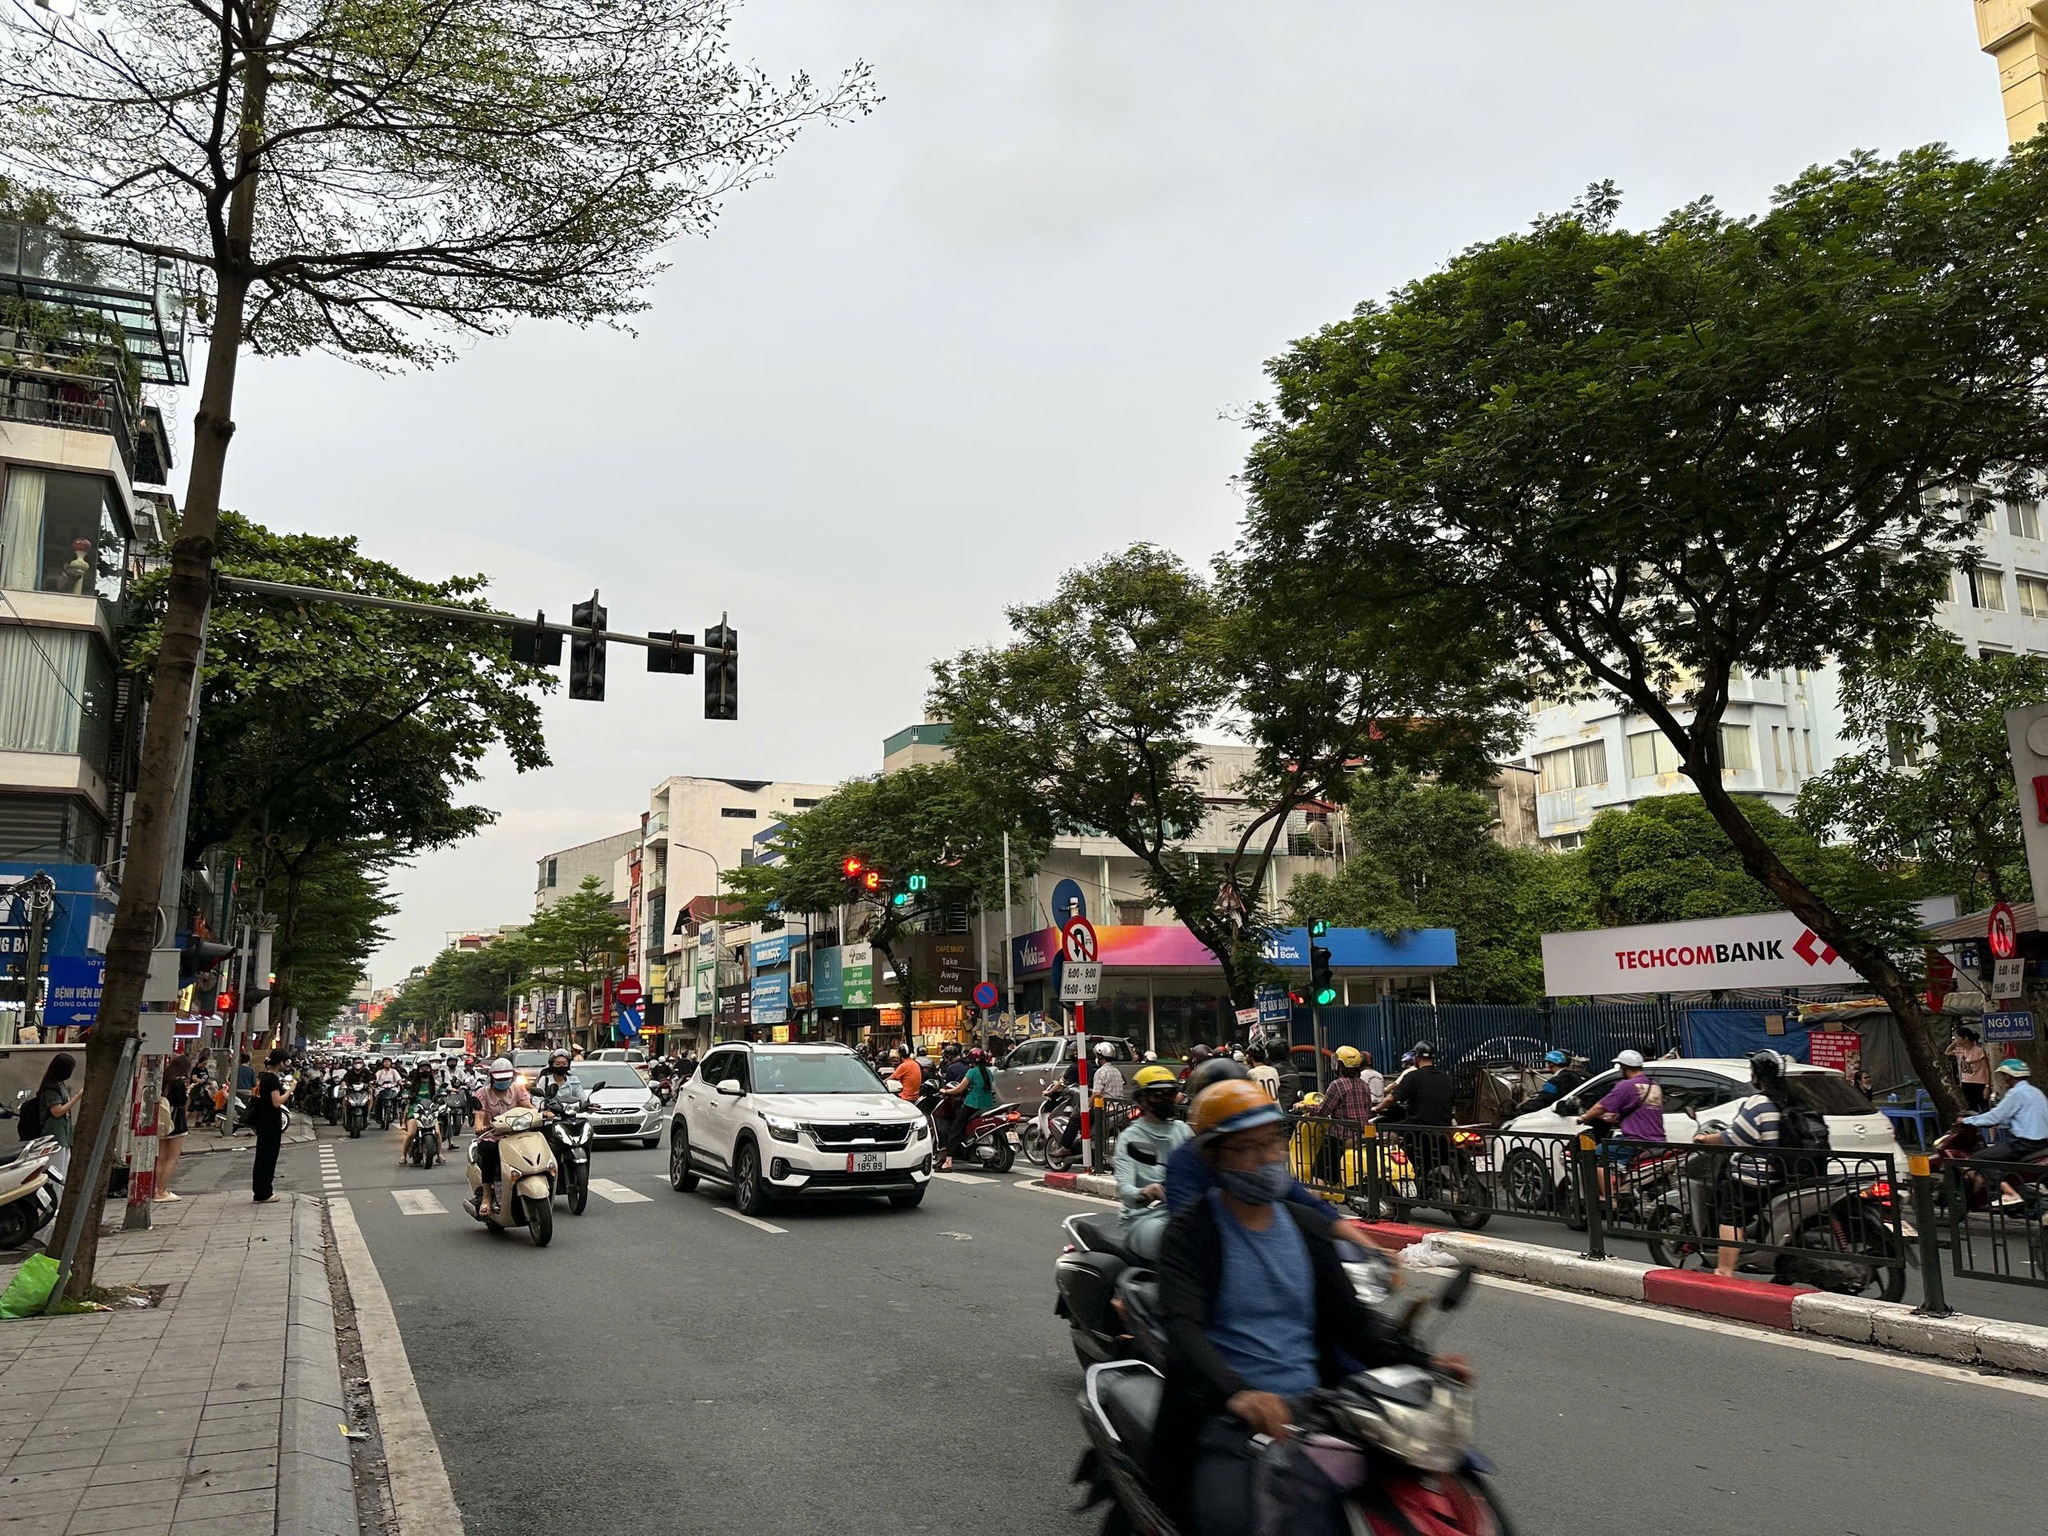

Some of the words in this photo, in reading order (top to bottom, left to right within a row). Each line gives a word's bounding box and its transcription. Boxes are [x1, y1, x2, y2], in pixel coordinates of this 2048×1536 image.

[867, 872, 878, 887] 12
[909, 875, 926, 890] 07
[1615, 940, 1784, 970] TECHCOMBANK
[942, 958, 958, 966] Take
[940, 971, 960, 980] Away
[1068, 968, 1079, 978] 6:00
[1085, 968, 1096, 978] 9:00
[55, 986, 74, 1000] BỆNH
[76, 986, 92, 1000] VIỆN
[1064, 984, 1078, 994] 16:00
[1084, 984, 1097, 994] 19:30
[1988, 1016, 2010, 1028] NGÕ
[2013, 1017, 2029, 1026] 161
[1260, 1078, 1278, 1100] 10
[863, 1154, 876, 1162] 30H
